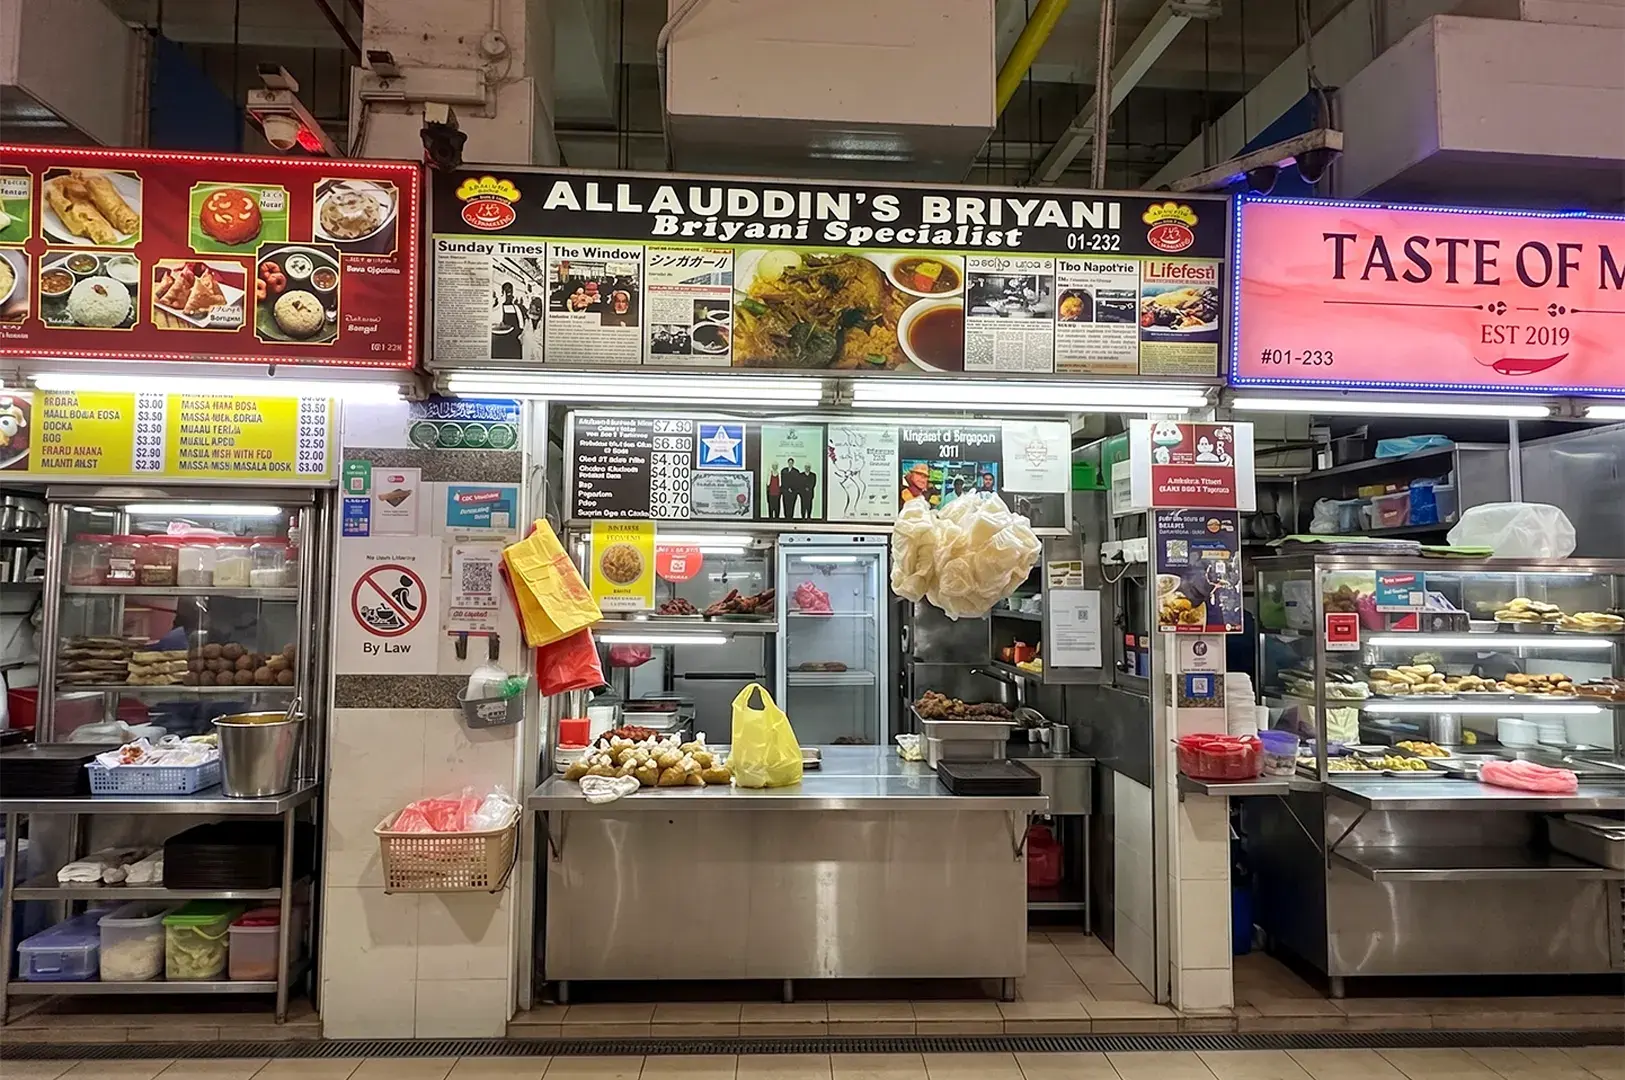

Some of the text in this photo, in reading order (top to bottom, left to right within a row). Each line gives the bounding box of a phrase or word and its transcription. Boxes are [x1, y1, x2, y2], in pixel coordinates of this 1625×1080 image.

[543, 180, 1120, 229] ALLAUDDIN'S BRIYANI
[651, 214, 1022, 247] Briyani Specialist
[438, 240, 542, 256] Sunday Times
[1066, 234, 1120, 251] 01-232
[552, 245, 579, 257] The
[582, 246, 640, 260] Window
[1321, 232, 1500, 285] TASTE
[1515, 240, 1583, 288] OF
[1480, 324, 1568, 345] EST 2019
[1260, 350, 1333, 366] #01-233
[138, 399, 163, 409] $3.00
[301, 402, 326, 412] $3.50
[138, 411, 163, 421] $3.50
[300, 414, 325, 425] $3.50
[137, 423, 162, 433] $3.50
[300, 426, 325, 437] $2.50
[136, 435, 161, 445] $3.30
[299, 439, 325, 449] $2.50
[136, 448, 161, 458] $2.90
[299, 451, 324, 461] $2.00
[135, 459, 160, 470] $2.30
[652, 454, 689, 465] $4.00
[298, 462, 324, 472] $3.00
[652, 467, 689, 478] $4.00
[651, 480, 689, 491] $4.00
[651, 492, 689, 504] $0.70
[650, 506, 689, 518] $0.70
[363, 642, 412, 656] By Law
